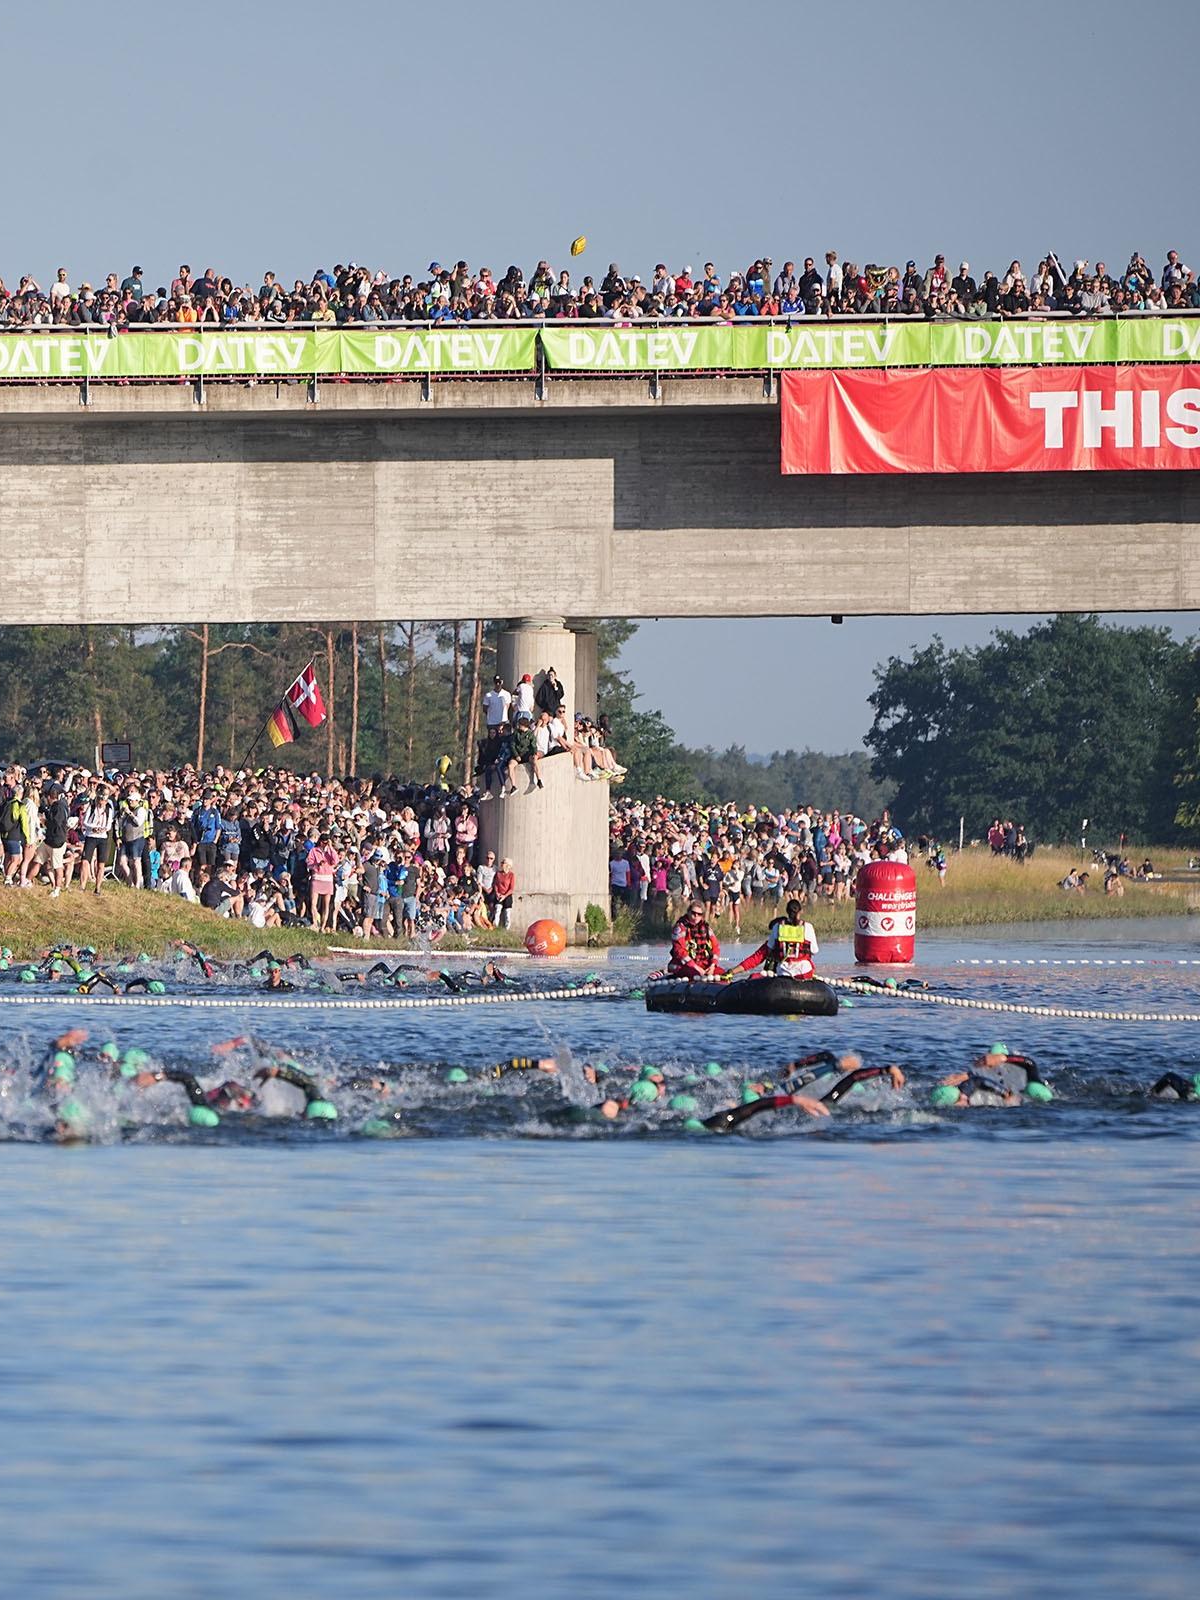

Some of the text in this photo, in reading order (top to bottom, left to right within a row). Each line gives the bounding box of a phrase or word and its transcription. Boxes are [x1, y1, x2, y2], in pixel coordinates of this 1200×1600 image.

[178, 336, 307, 371] DATEV
[375, 333, 504, 369] DATEV
[569, 331, 698, 366] DATEV
[766, 329, 896, 364] DATEV
[964, 325, 1095, 360] DATEV
[1029, 388, 1200, 449] THIS
[868, 892, 912, 902] CHALLENGE
